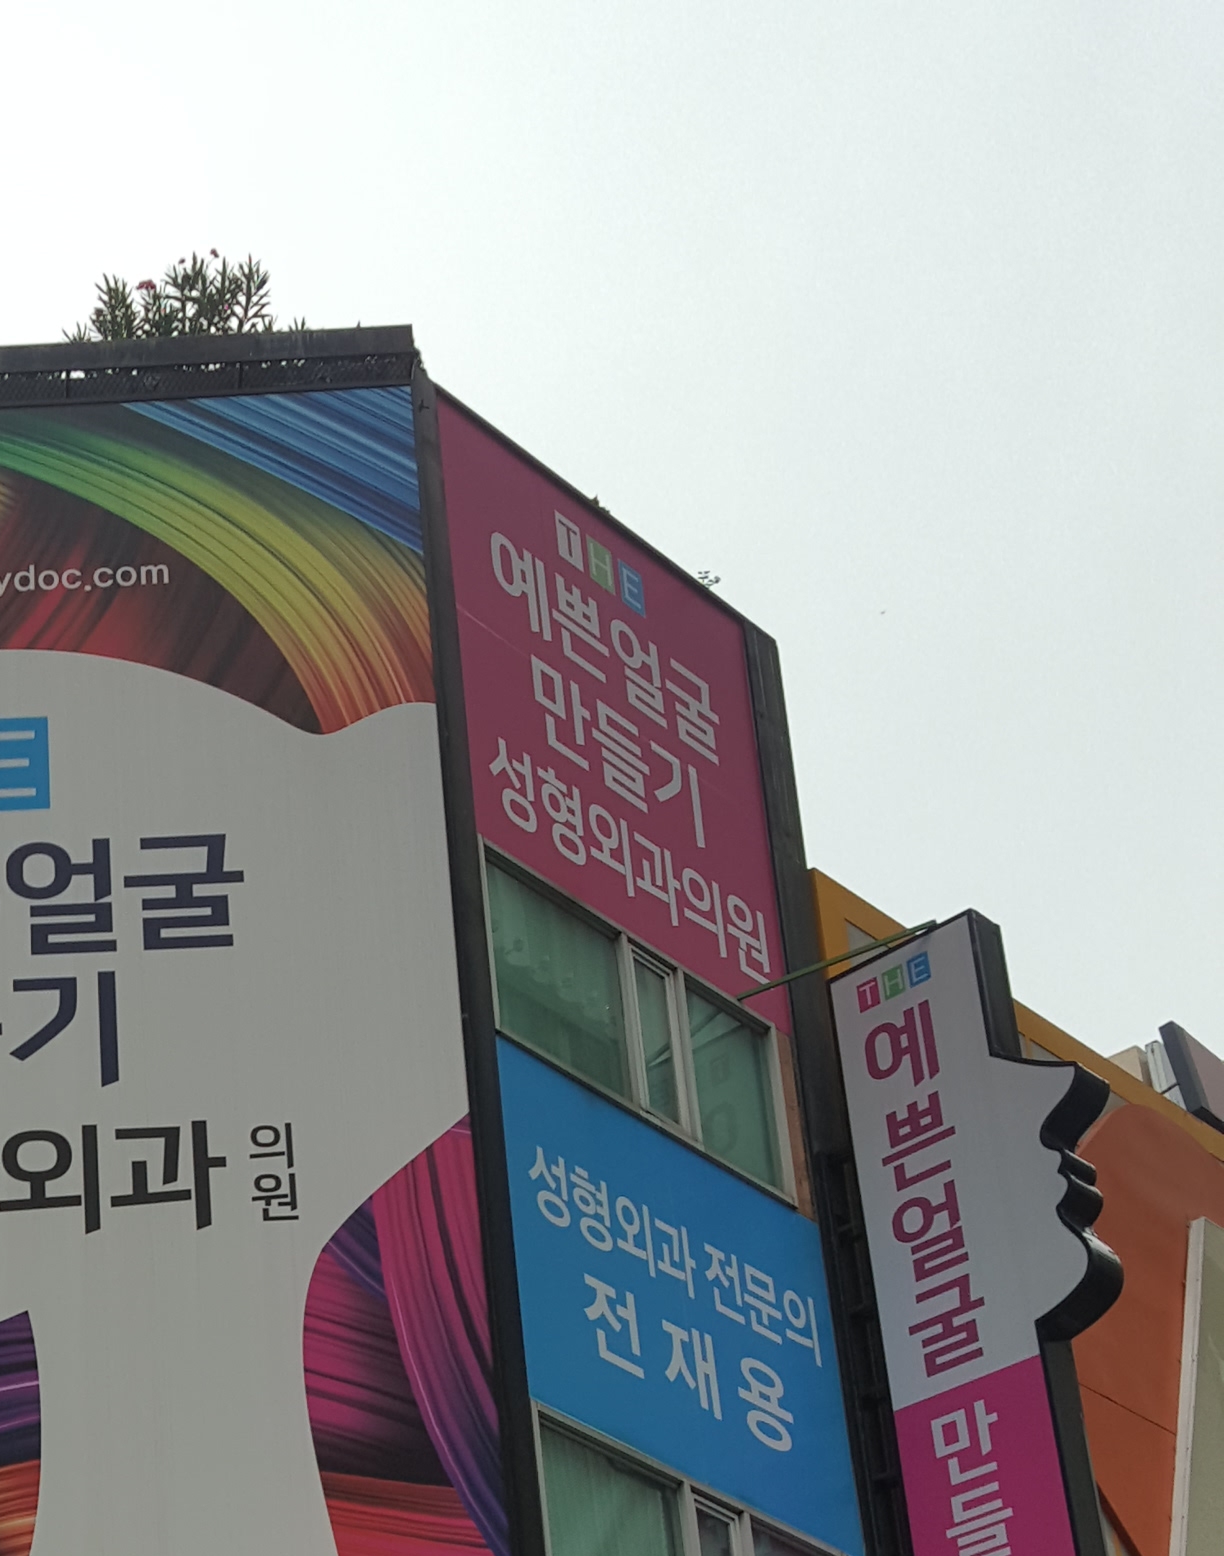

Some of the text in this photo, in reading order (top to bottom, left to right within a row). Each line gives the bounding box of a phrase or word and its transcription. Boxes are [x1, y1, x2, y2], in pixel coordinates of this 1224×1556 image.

[491, 531, 720, 766] 예쁜얼굴
[530, 654, 706, 848] 만들기
[489, 737, 773, 986] 성형외과의원
[856, 950, 932, 1013] THE
[249, 1122, 299, 1222] 의원
[528, 1146, 822, 1368] 성형외과 전문의
[863, 1000, 985, 1379] 예쁜얼굴
